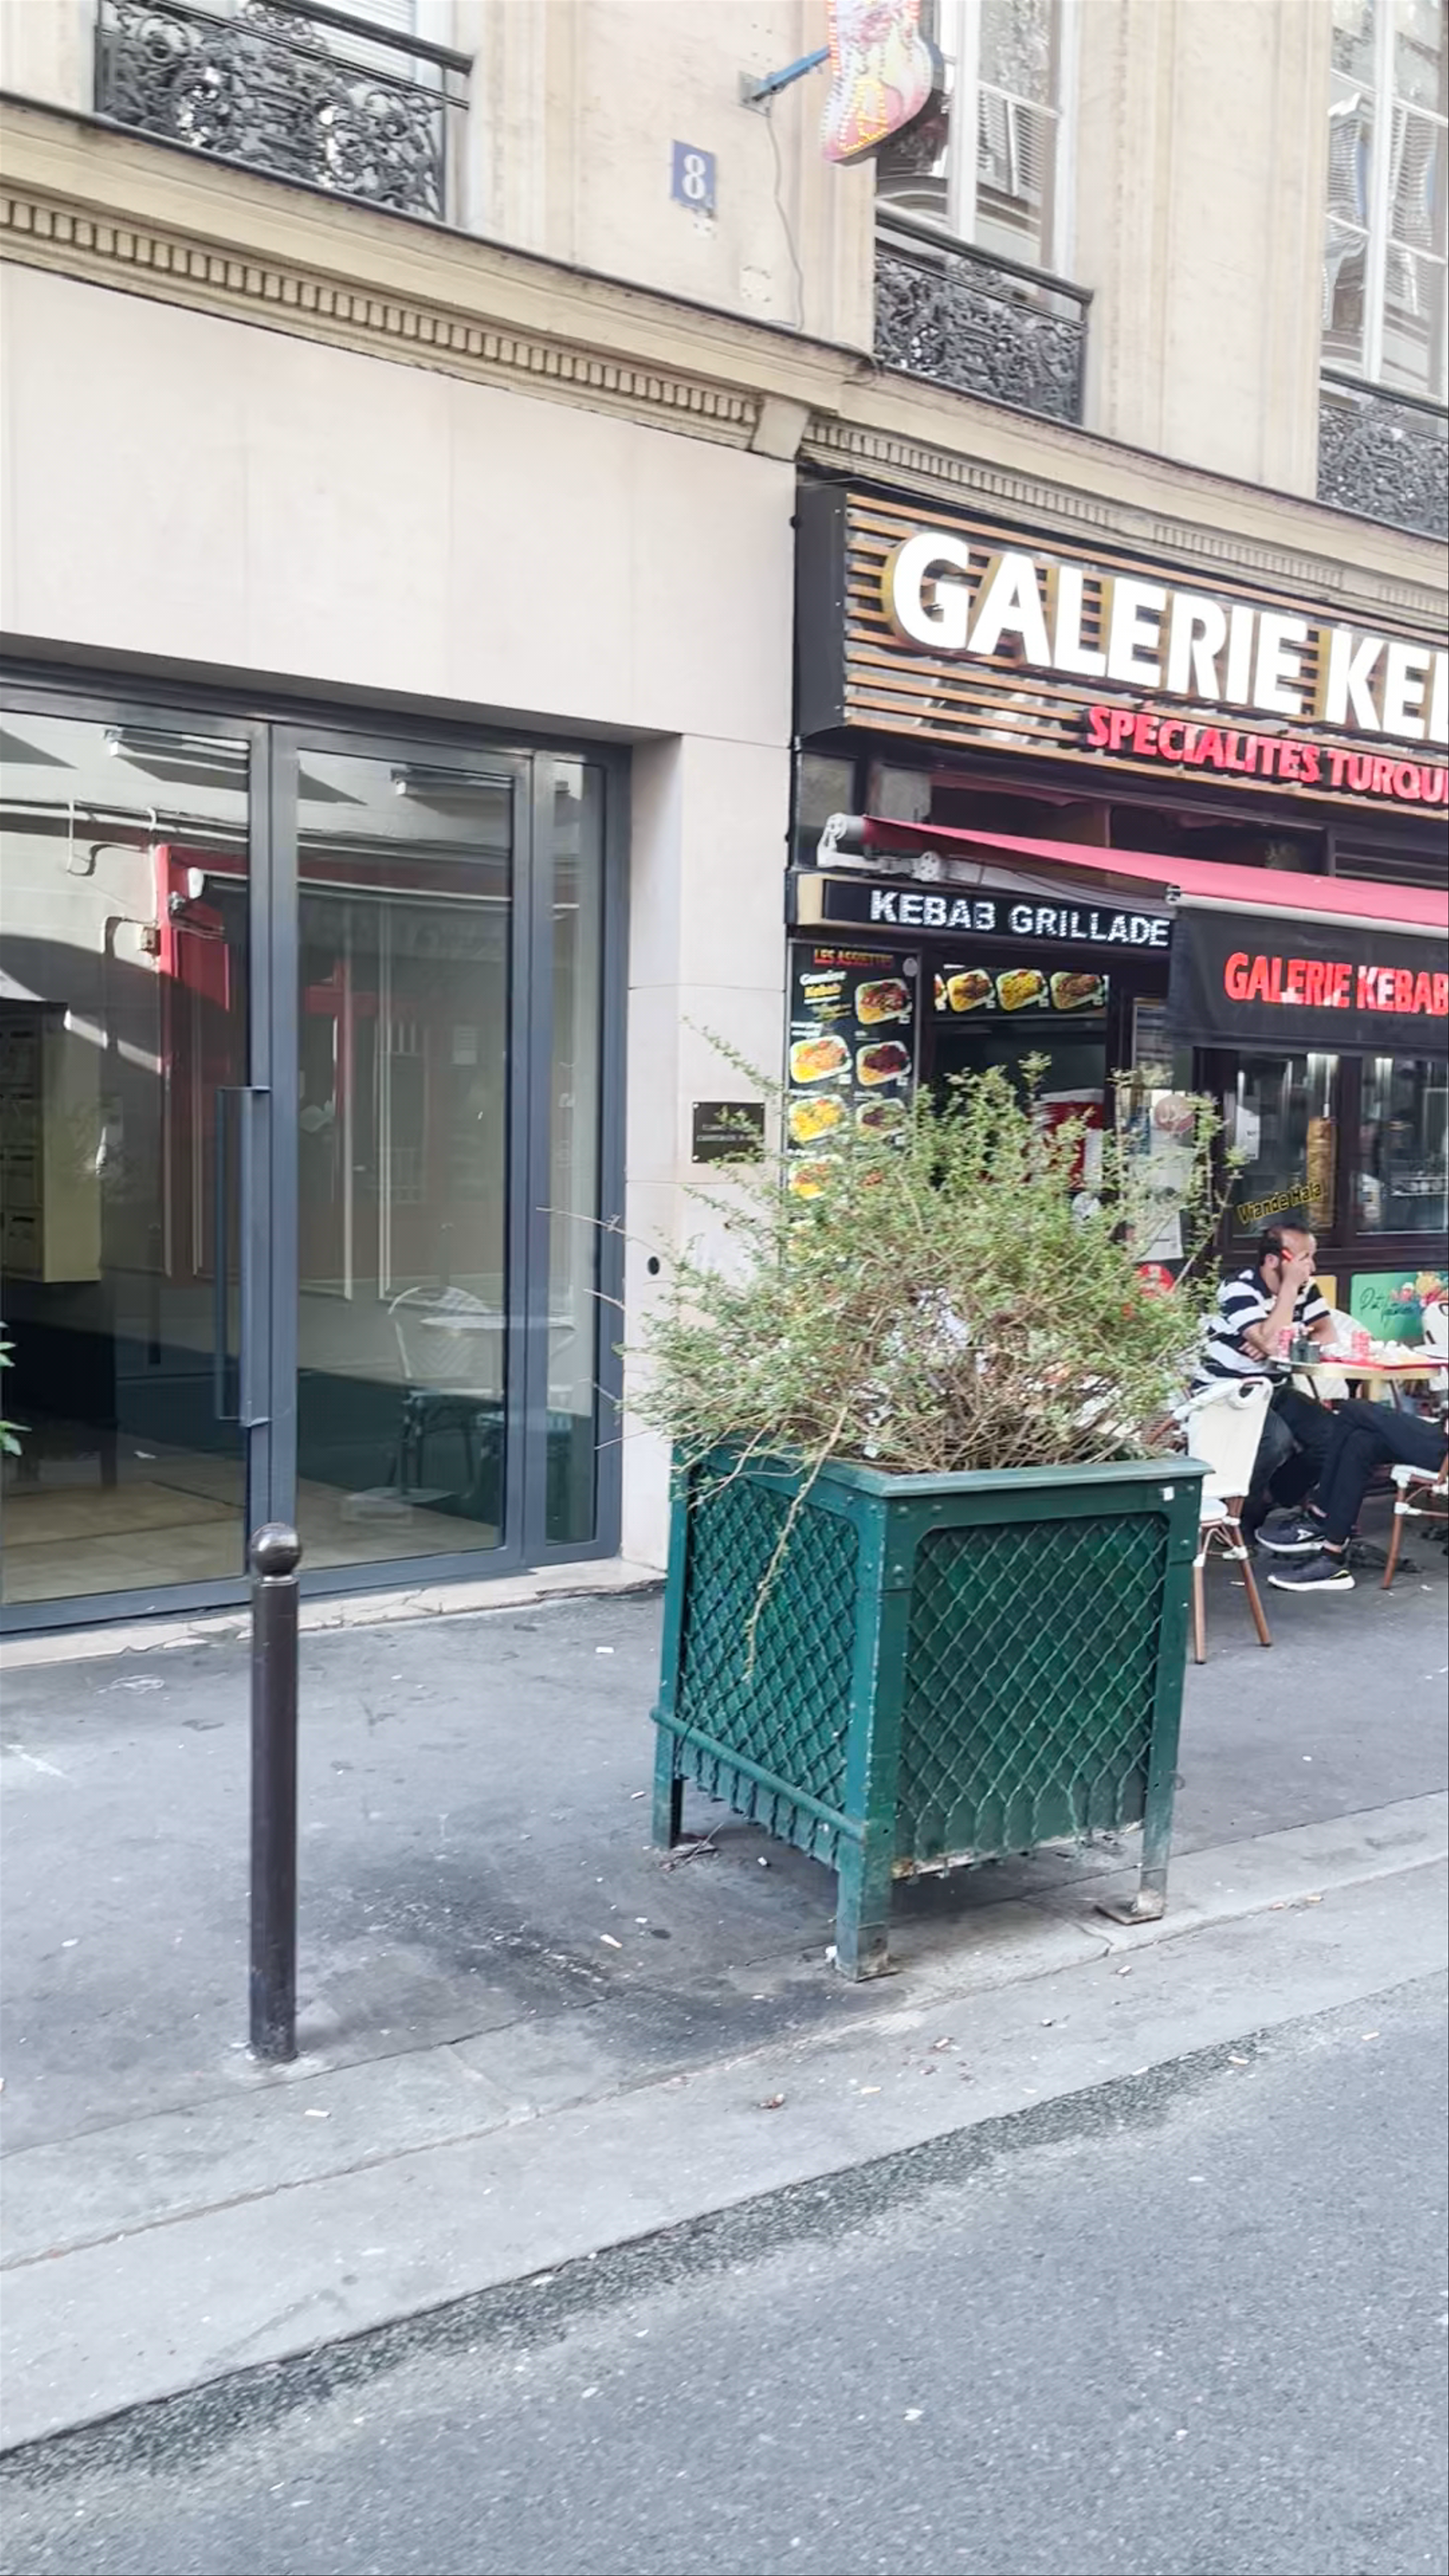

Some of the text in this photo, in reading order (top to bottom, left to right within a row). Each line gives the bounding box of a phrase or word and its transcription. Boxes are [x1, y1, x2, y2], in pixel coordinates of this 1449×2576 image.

[682, 154, 706, 200] 8
[891, 532, 1308, 716] GALERIE
[871, 890, 1169, 946] KEBAB GRILLADE
[1225, 952, 1448, 1015] GALERIE KEBAB
